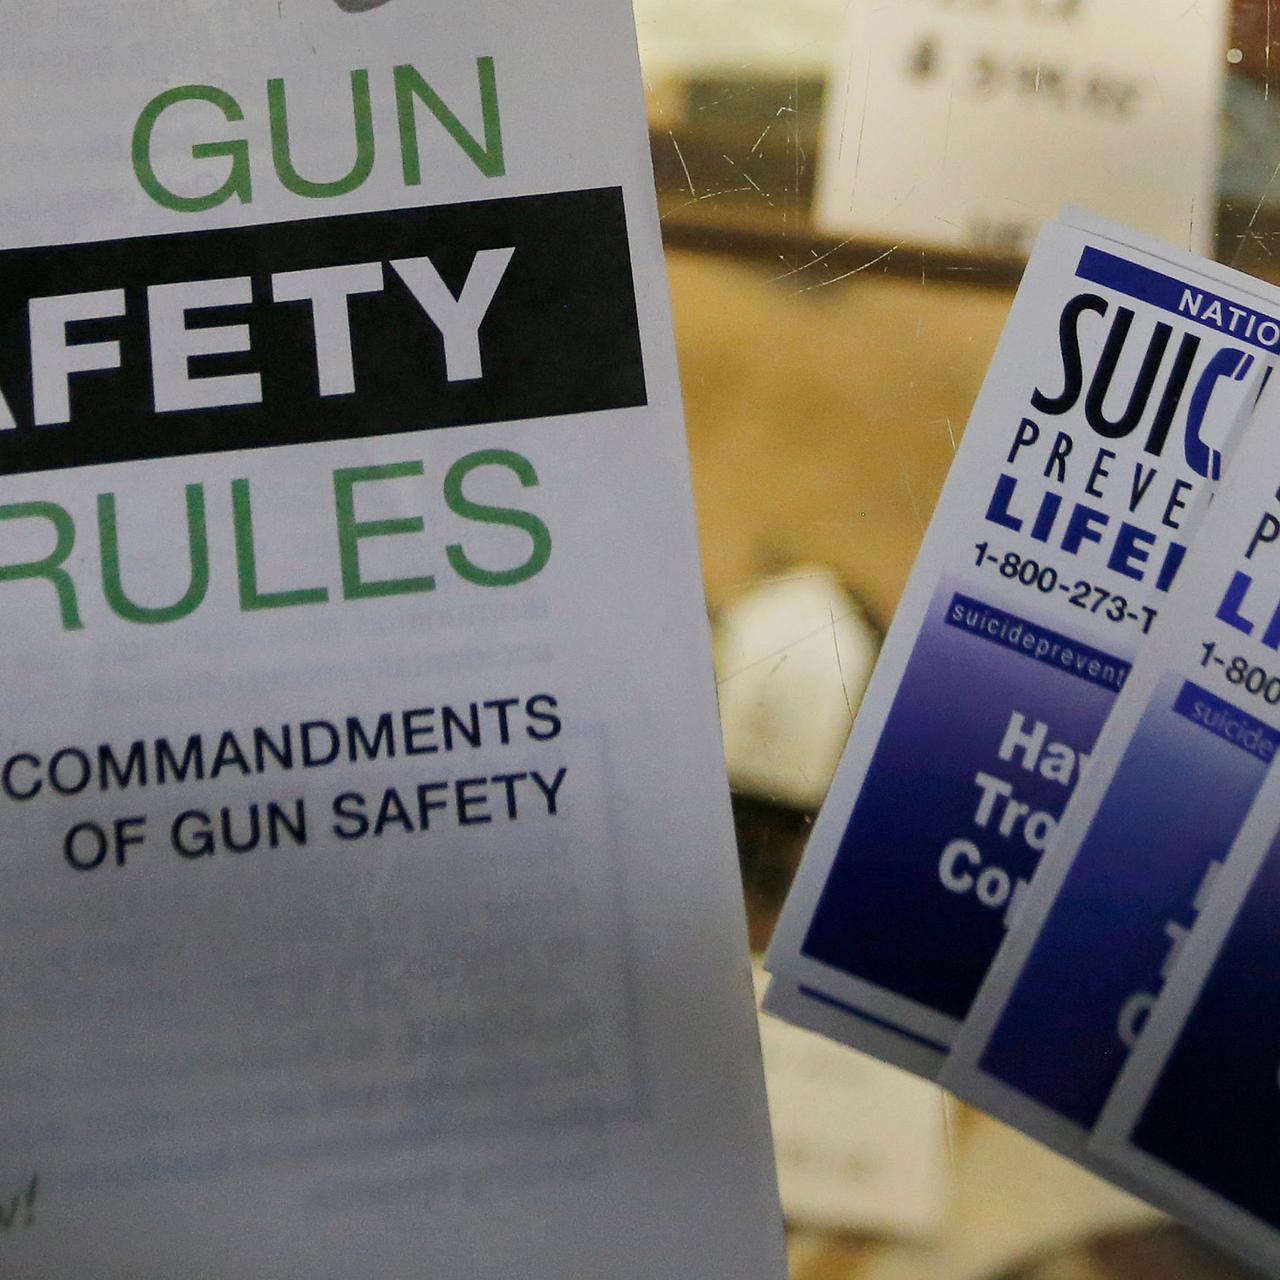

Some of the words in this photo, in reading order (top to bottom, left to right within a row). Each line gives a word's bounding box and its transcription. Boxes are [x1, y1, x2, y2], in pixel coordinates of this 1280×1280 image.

[130, 55, 508, 214] GUN
[1177, 288, 1280, 348] NATIO
[1006, 417, 1215, 530] PREVE
[973, 540, 1159, 635] 1-800-273-T
[0, 693, 564, 803] COMMANDMENTS
[1190, 698, 1276, 763] suicide
[63, 816, 147, 872] OF
[169, 799, 308, 860] GUN
[332, 767, 569, 842] SAFETY
